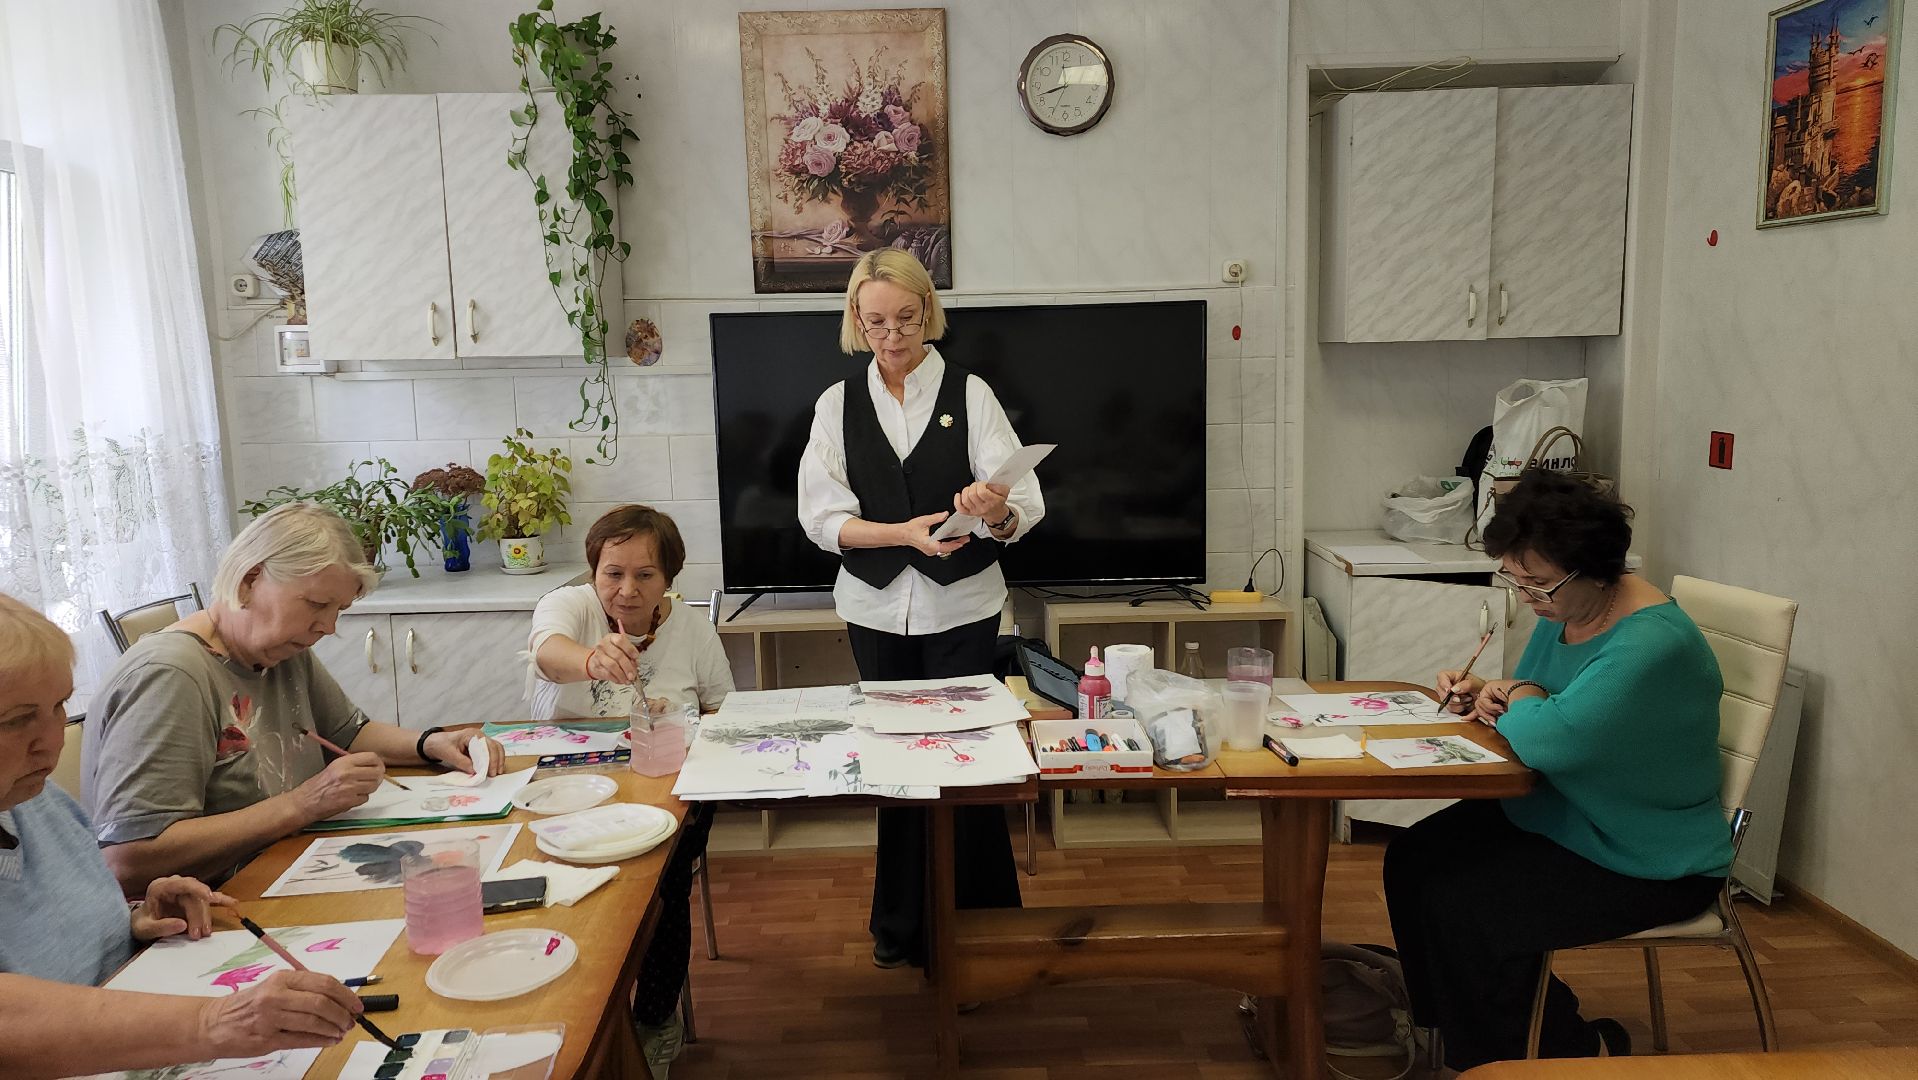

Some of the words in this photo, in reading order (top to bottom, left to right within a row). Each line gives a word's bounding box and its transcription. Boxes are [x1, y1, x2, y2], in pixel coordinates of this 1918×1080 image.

[1049, 55, 1058, 66] 11
[1062, 51, 1070, 62] 12
[1040, 66, 1051, 76] 10
[1039, 97, 1045, 106] 8
[1086, 96, 1092, 104] 4
[1062, 110, 1068, 119] 6
[1074, 107, 1081, 116] 5
